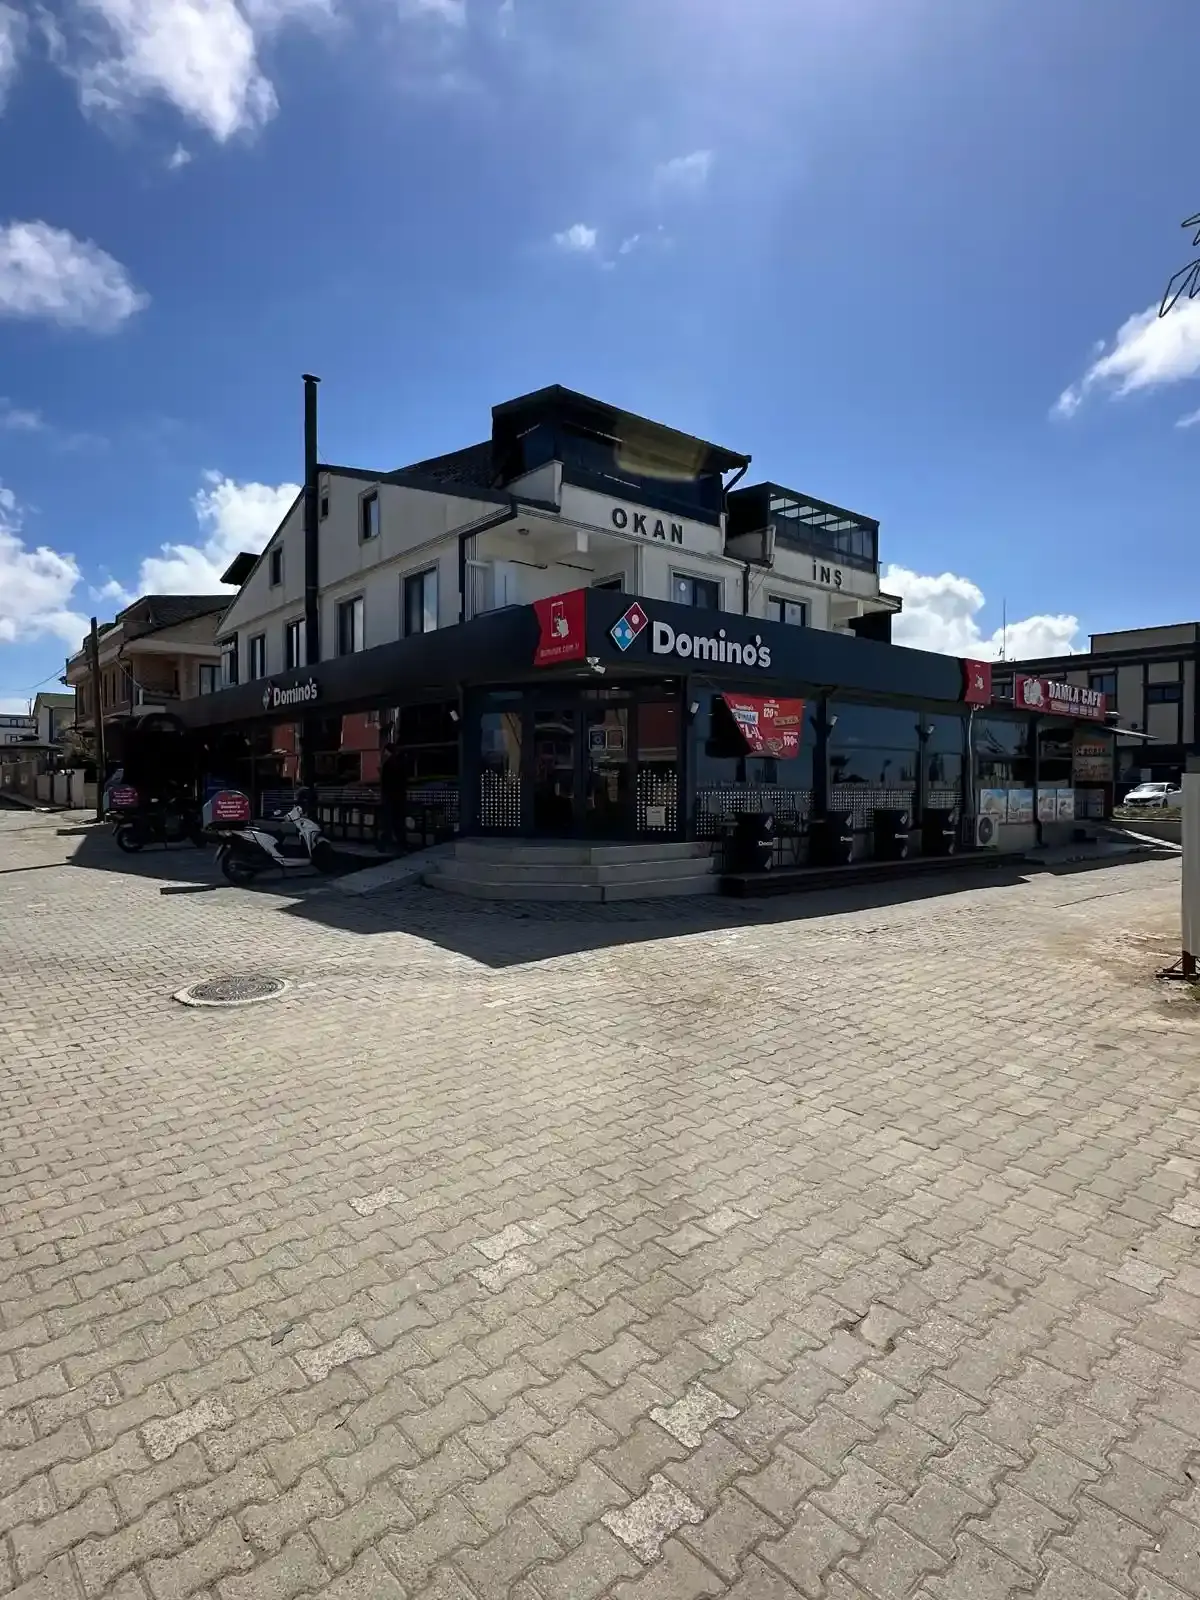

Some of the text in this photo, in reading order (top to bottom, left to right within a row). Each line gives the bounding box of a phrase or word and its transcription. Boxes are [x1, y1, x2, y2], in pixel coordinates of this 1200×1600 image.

[612, 508, 684, 545] OKAN
[812, 560, 843, 587] İNŞ
[652, 620, 772, 668] Domino's
[273, 677, 318, 707] Domino's
[1048, 683, 1080, 703] DAMLA
